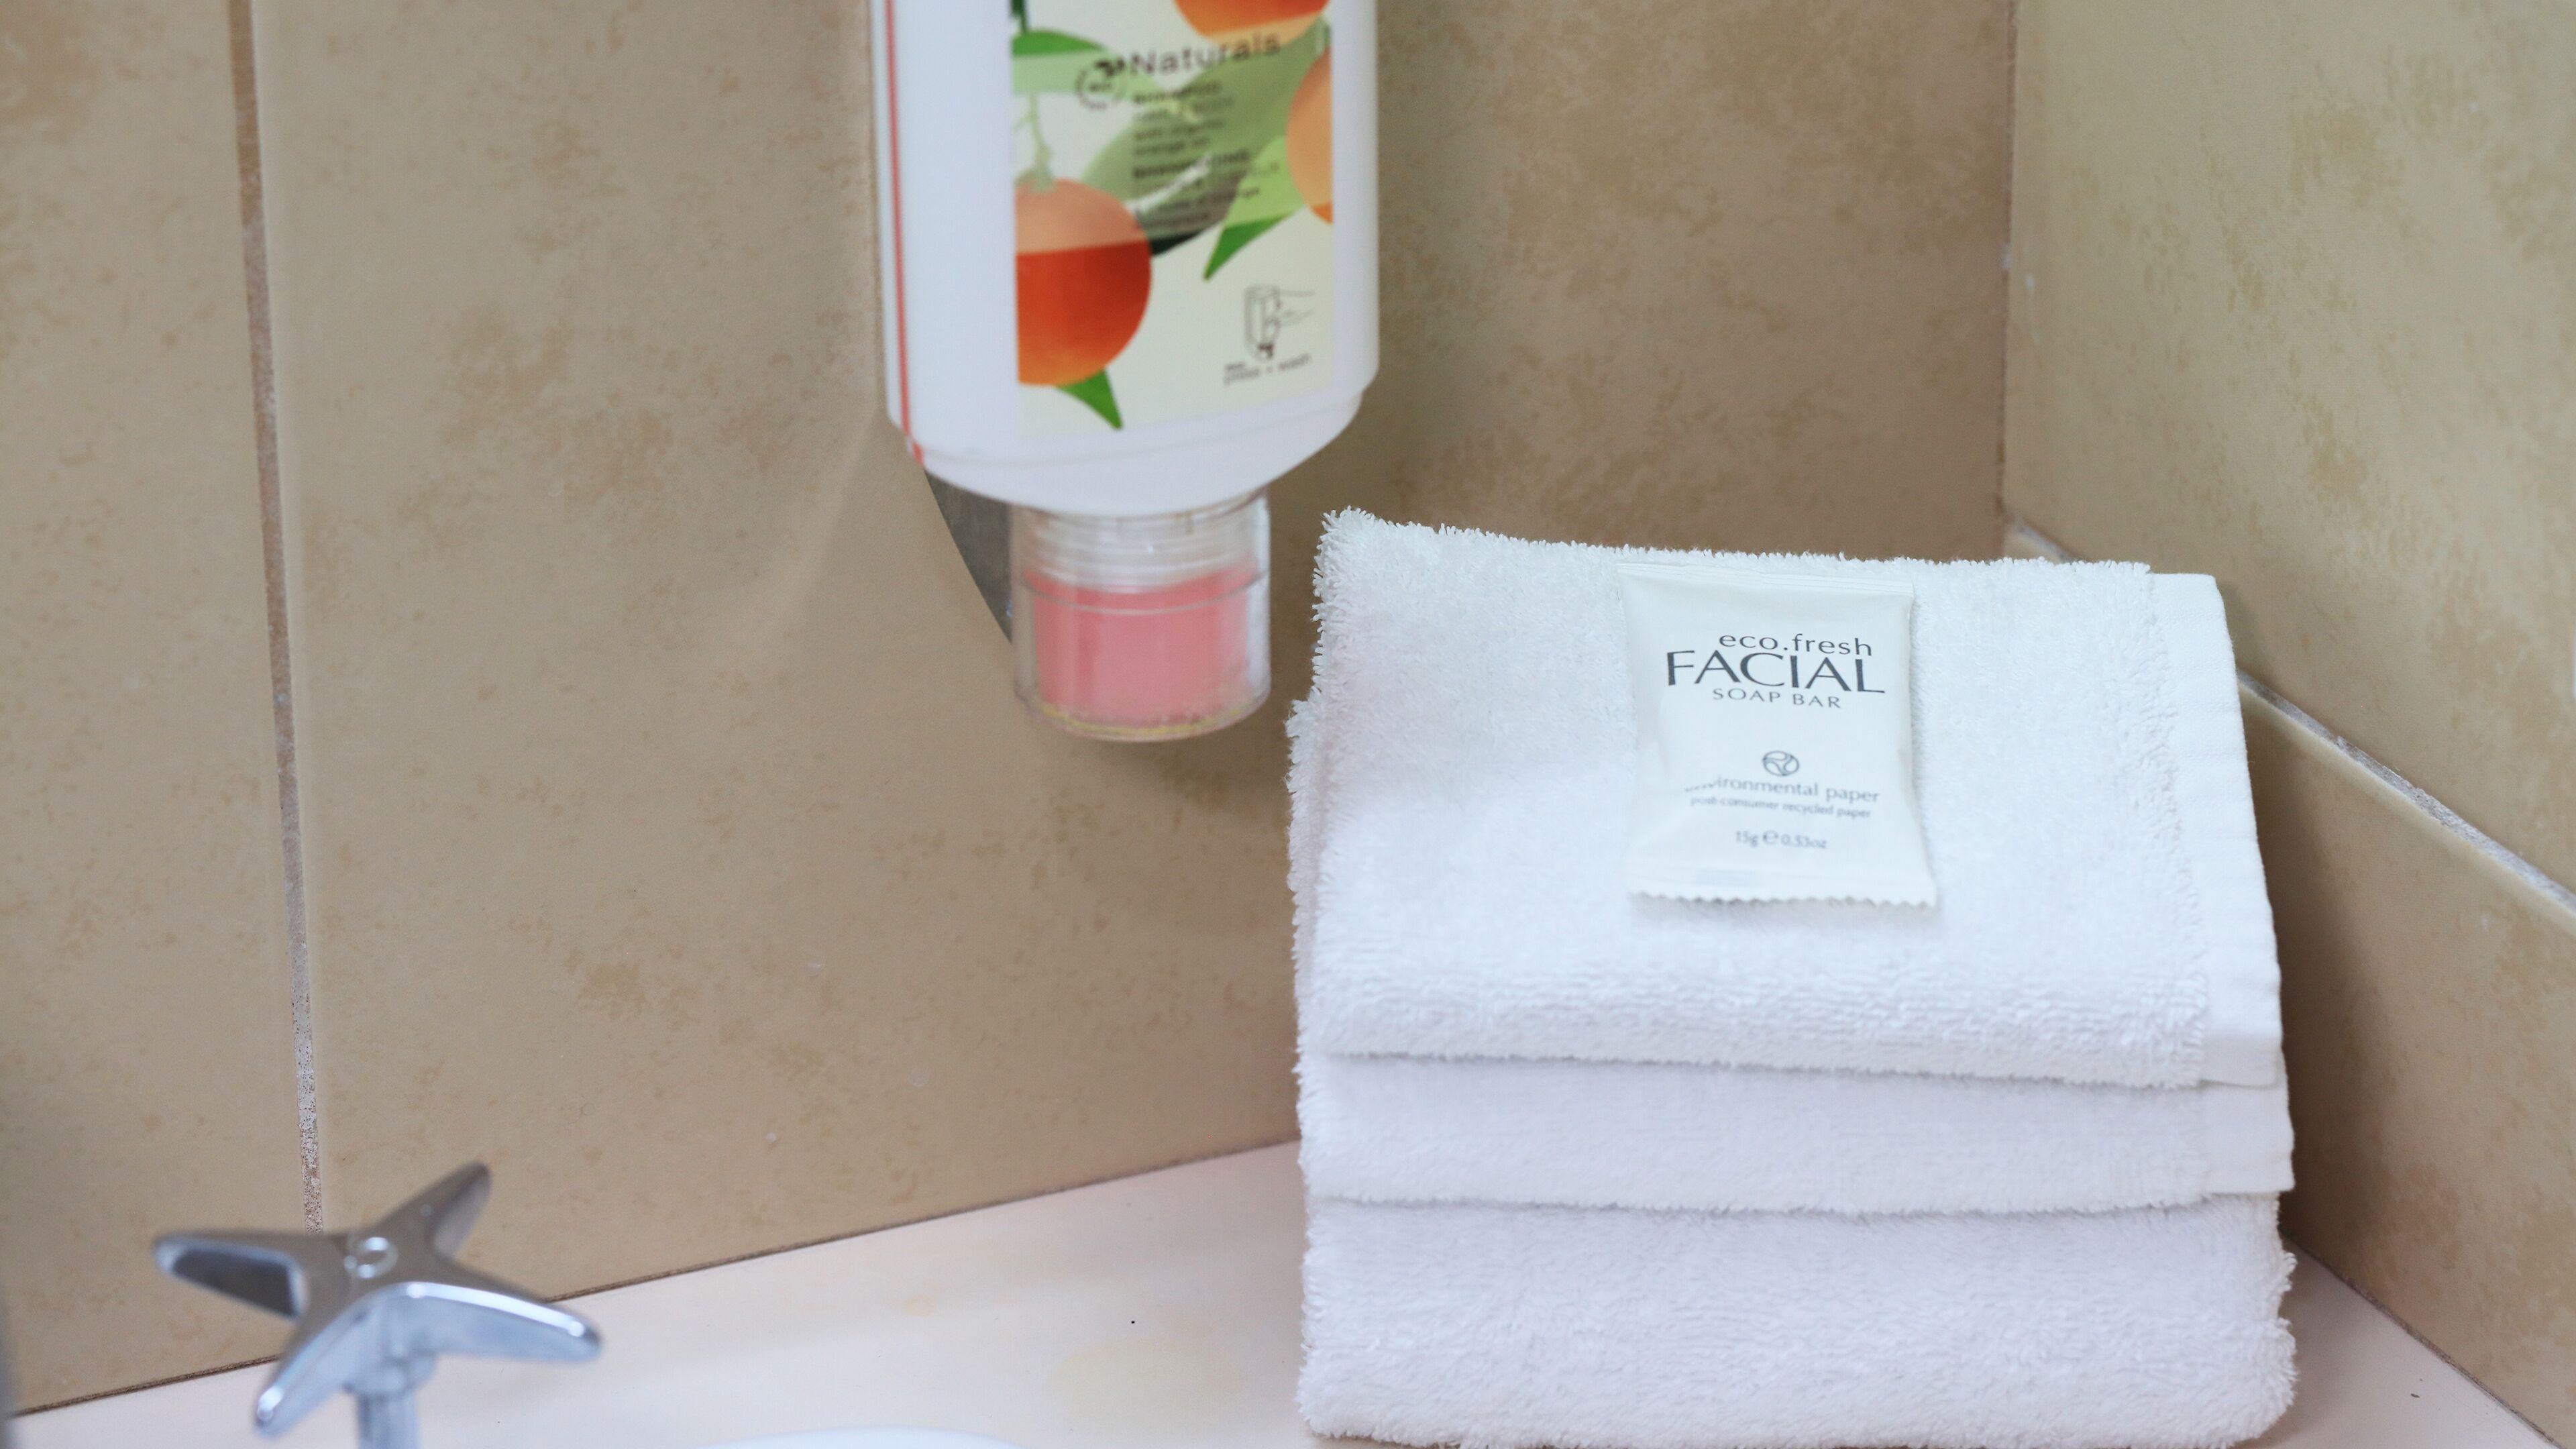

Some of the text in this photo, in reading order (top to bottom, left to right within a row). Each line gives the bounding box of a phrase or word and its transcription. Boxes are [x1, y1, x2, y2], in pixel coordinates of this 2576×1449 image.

[1130, 32, 1281, 76] Naturals
[1718, 633, 1872, 657] eco.fresh
[1666, 649, 1886, 694] FACIAL
[1712, 688, 1842, 709] SOAP BAR
[1826, 788, 1880, 804] paper
[1782, 802, 1835, 815] recycled
[1837, 807, 1872, 820] paper
[1735, 830, 1759, 848] 15g
